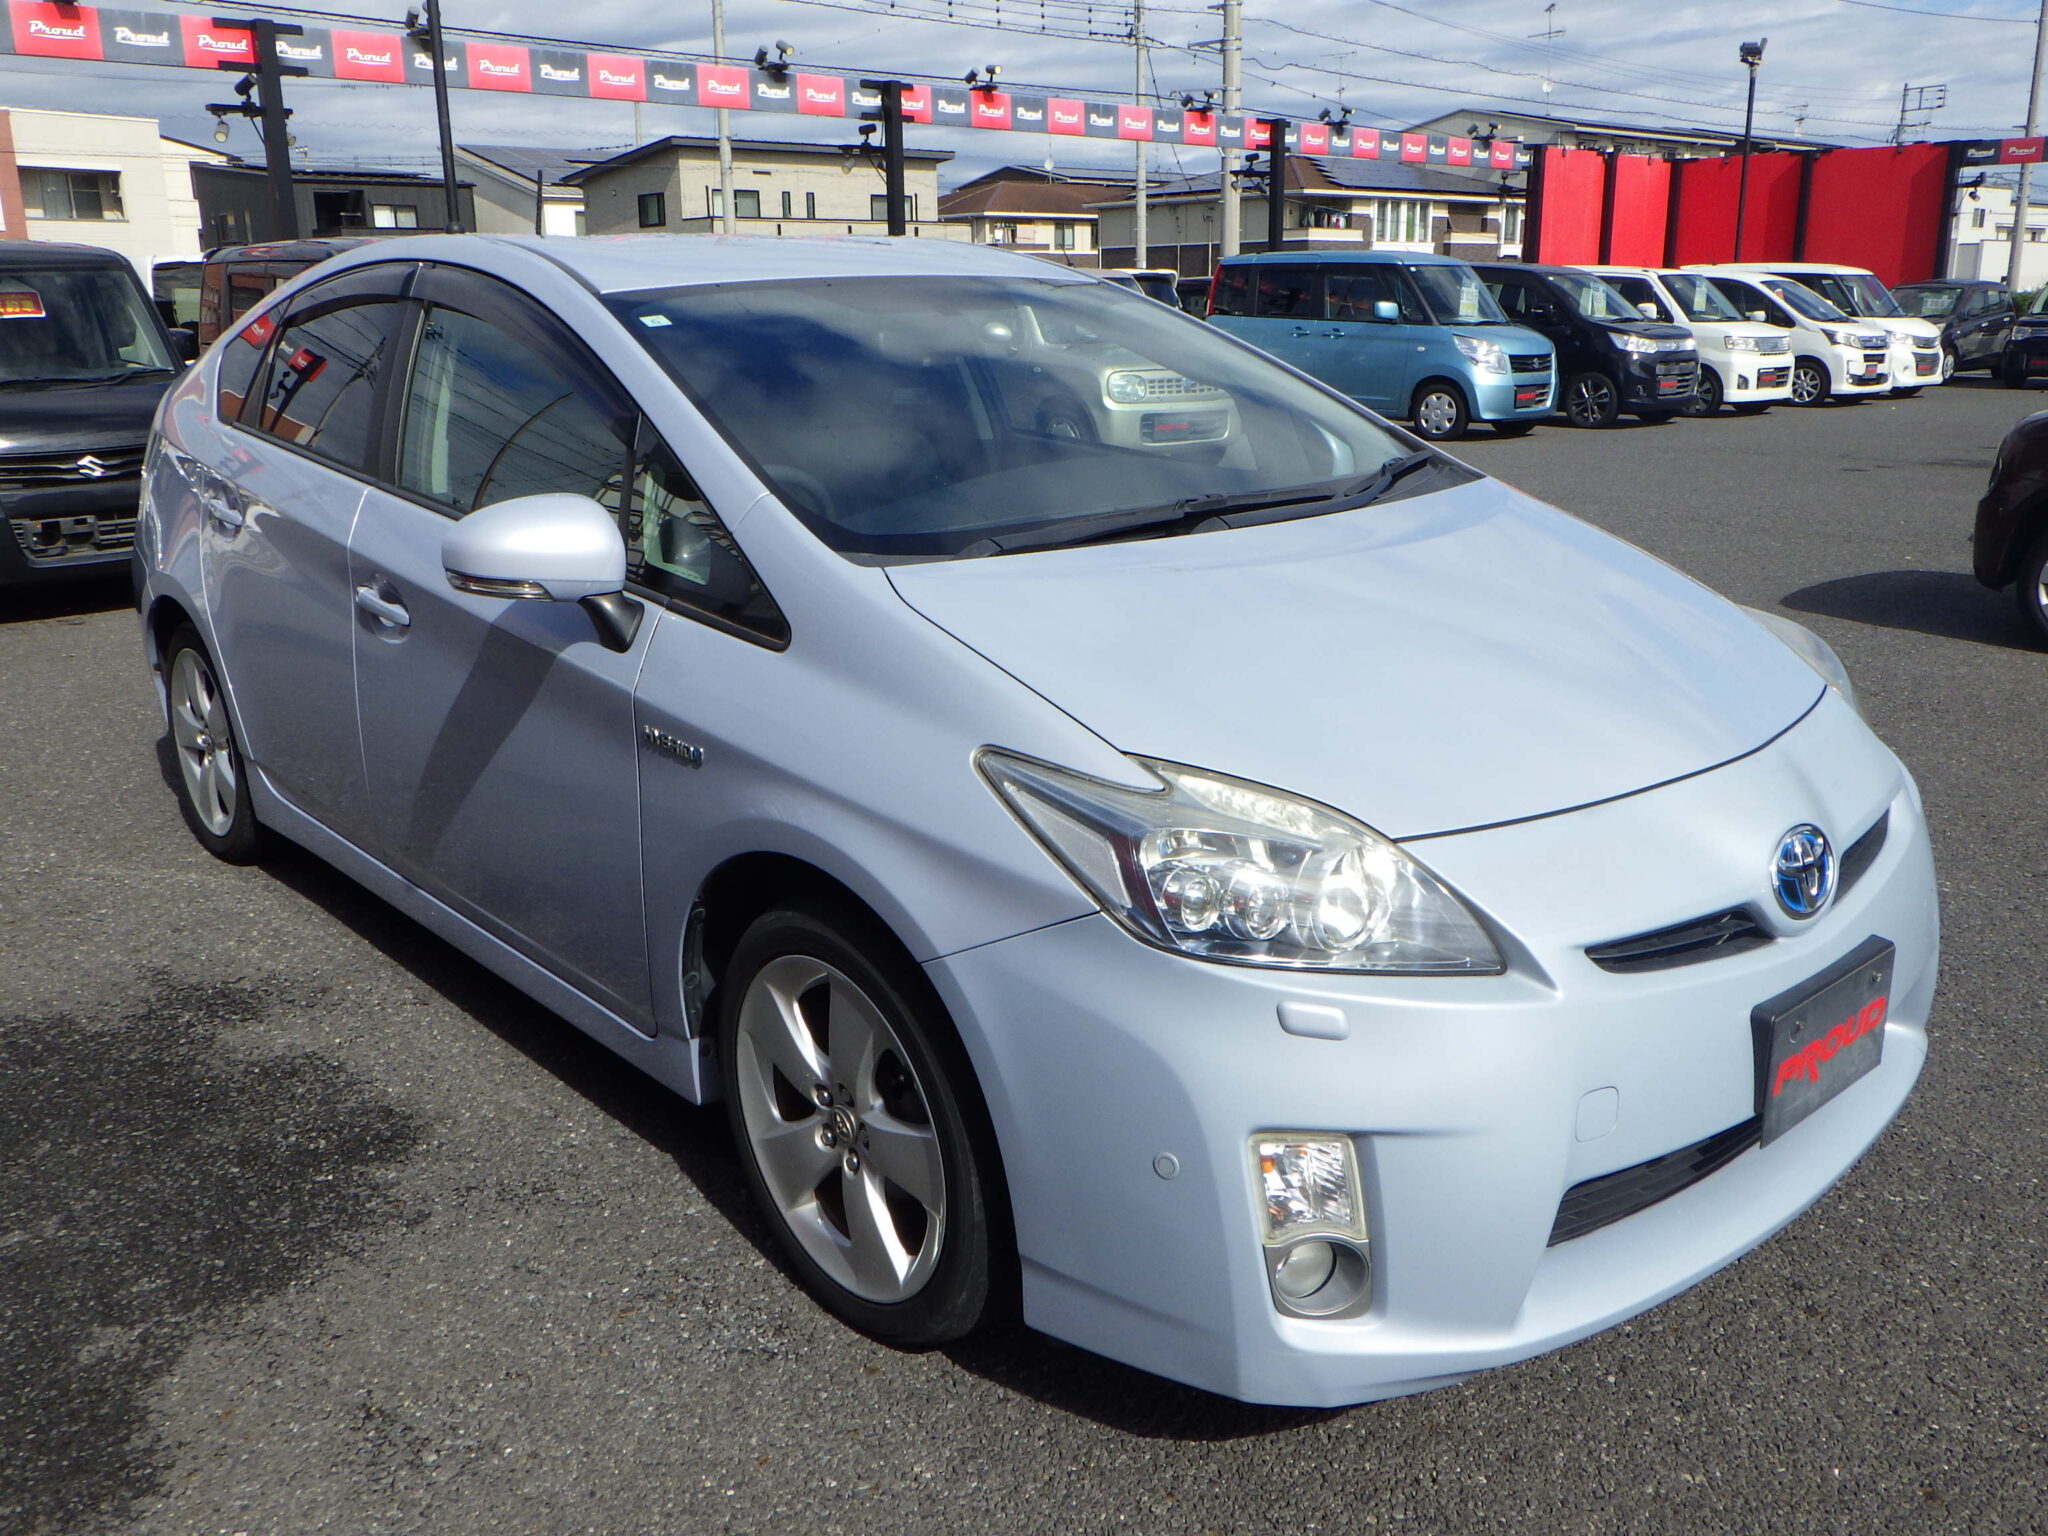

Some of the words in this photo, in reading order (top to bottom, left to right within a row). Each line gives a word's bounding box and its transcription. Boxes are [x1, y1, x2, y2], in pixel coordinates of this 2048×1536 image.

[29, 20, 86, 38] Proud
[114, 27, 170, 46] Proud
[197, 35, 248, 52] Proud
[275, 41, 322, 59] Proud
[346, 48, 391, 64] Proud
[413, 53, 458, 70] Prd
[479, 59, 521, 75] Proud
[539, 64, 580, 80] Proud
[599, 70, 636, 85] Proud
[653, 74, 690, 90] Proud
[707, 80, 741, 94] Proud
[1772, 996, 1887, 1097] PROUD
